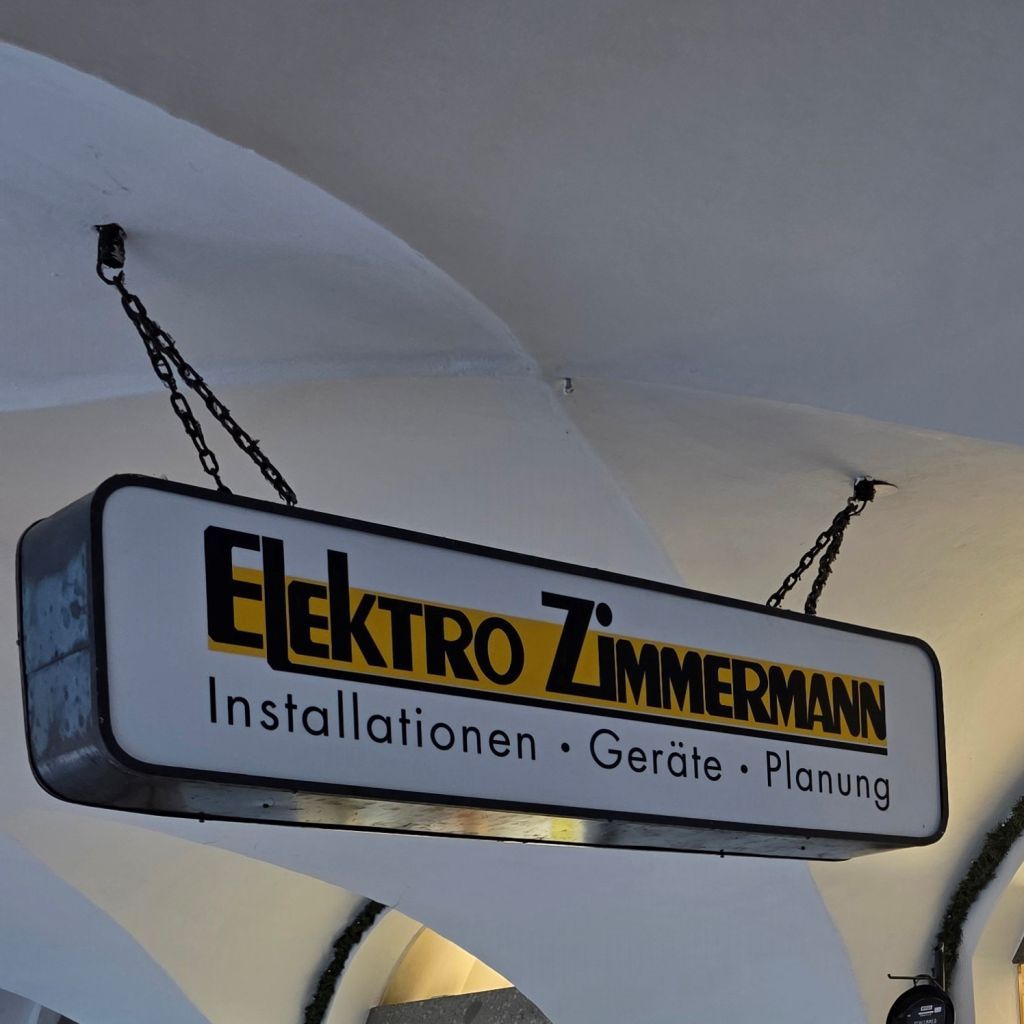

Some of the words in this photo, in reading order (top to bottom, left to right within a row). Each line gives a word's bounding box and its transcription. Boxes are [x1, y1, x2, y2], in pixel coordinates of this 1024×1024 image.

[208, 675, 537, 761] Installationen
[589, 728, 723, 782] Geräte
[765, 750, 891, 812] Planung
